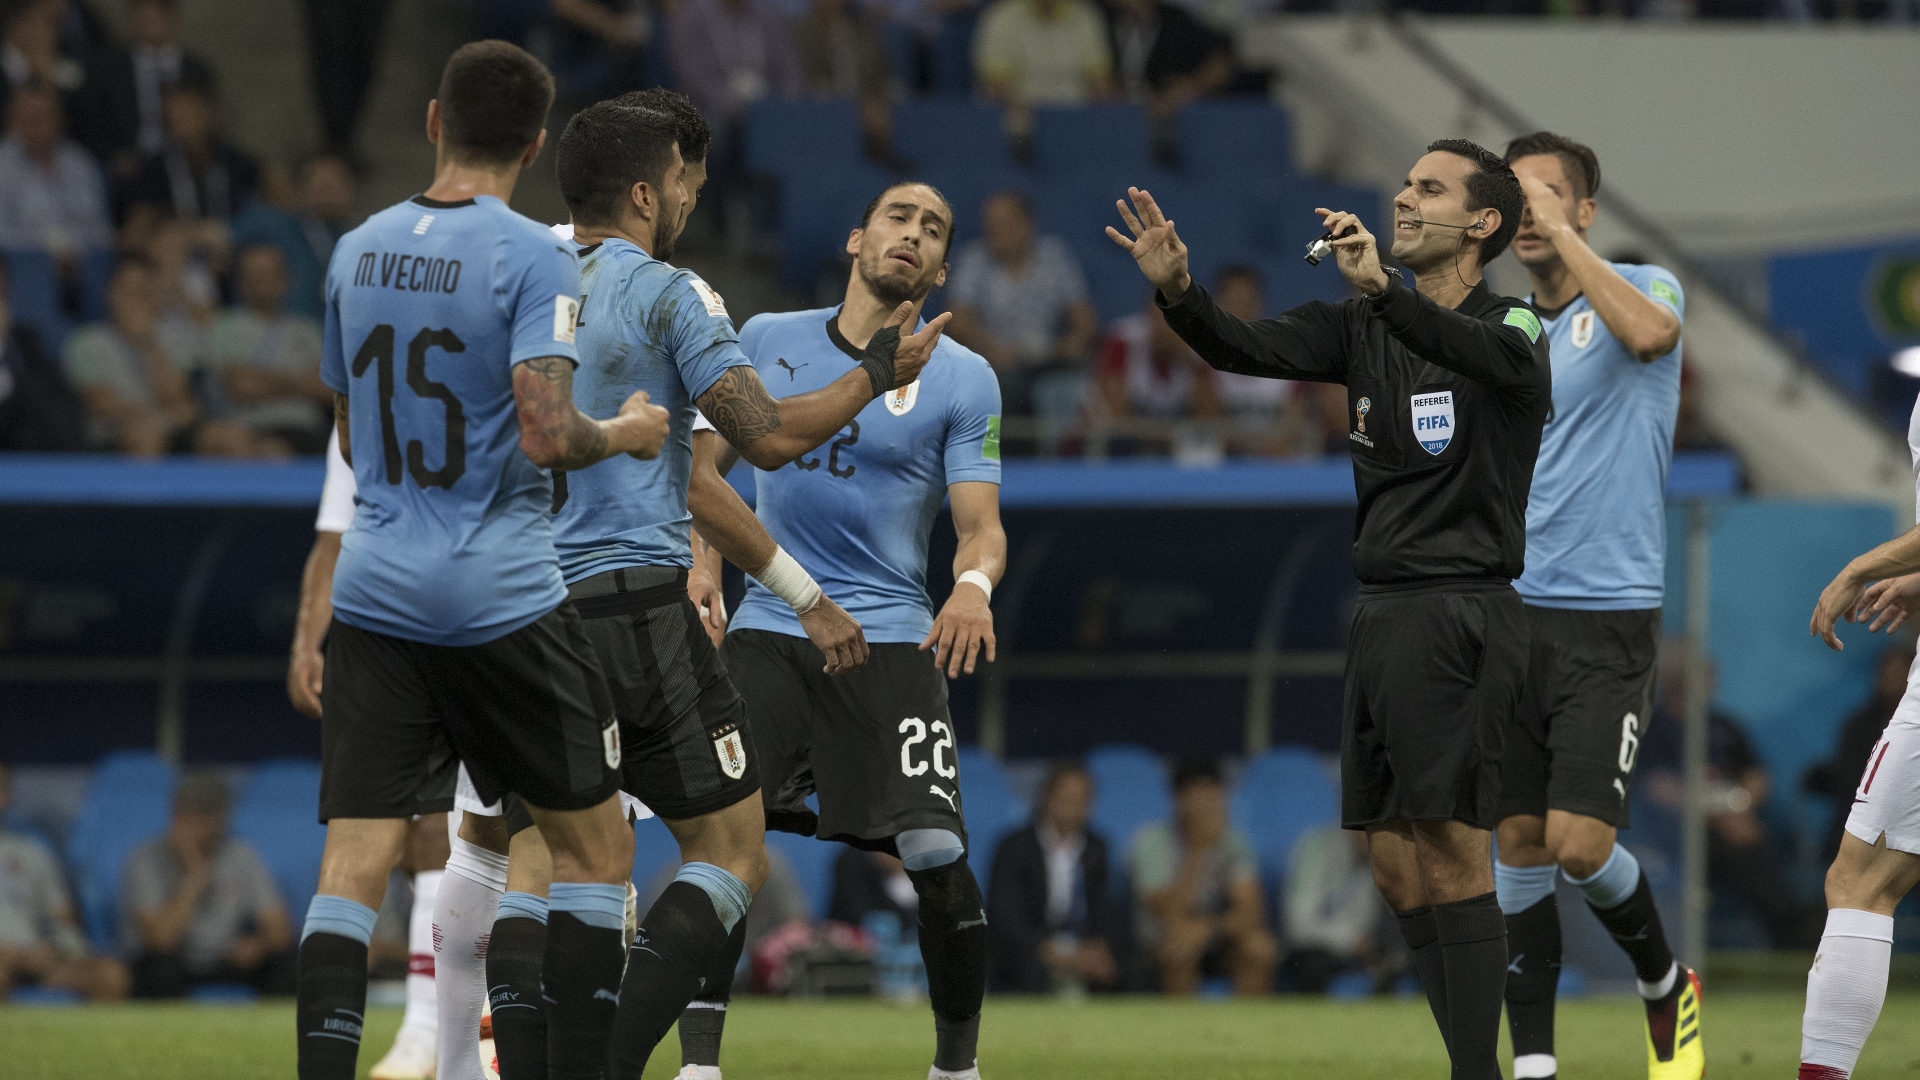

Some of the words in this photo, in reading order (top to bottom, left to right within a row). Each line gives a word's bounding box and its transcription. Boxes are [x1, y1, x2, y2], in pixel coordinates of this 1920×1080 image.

[352, 324, 466, 490] 15
[1414, 396, 1450, 408] REFEREE
[1417, 415, 1450, 431] FIFA
[1428, 442, 1443, 450] 2018
[898, 717, 956, 780] 22
[1618, 711, 1638, 774] 6
